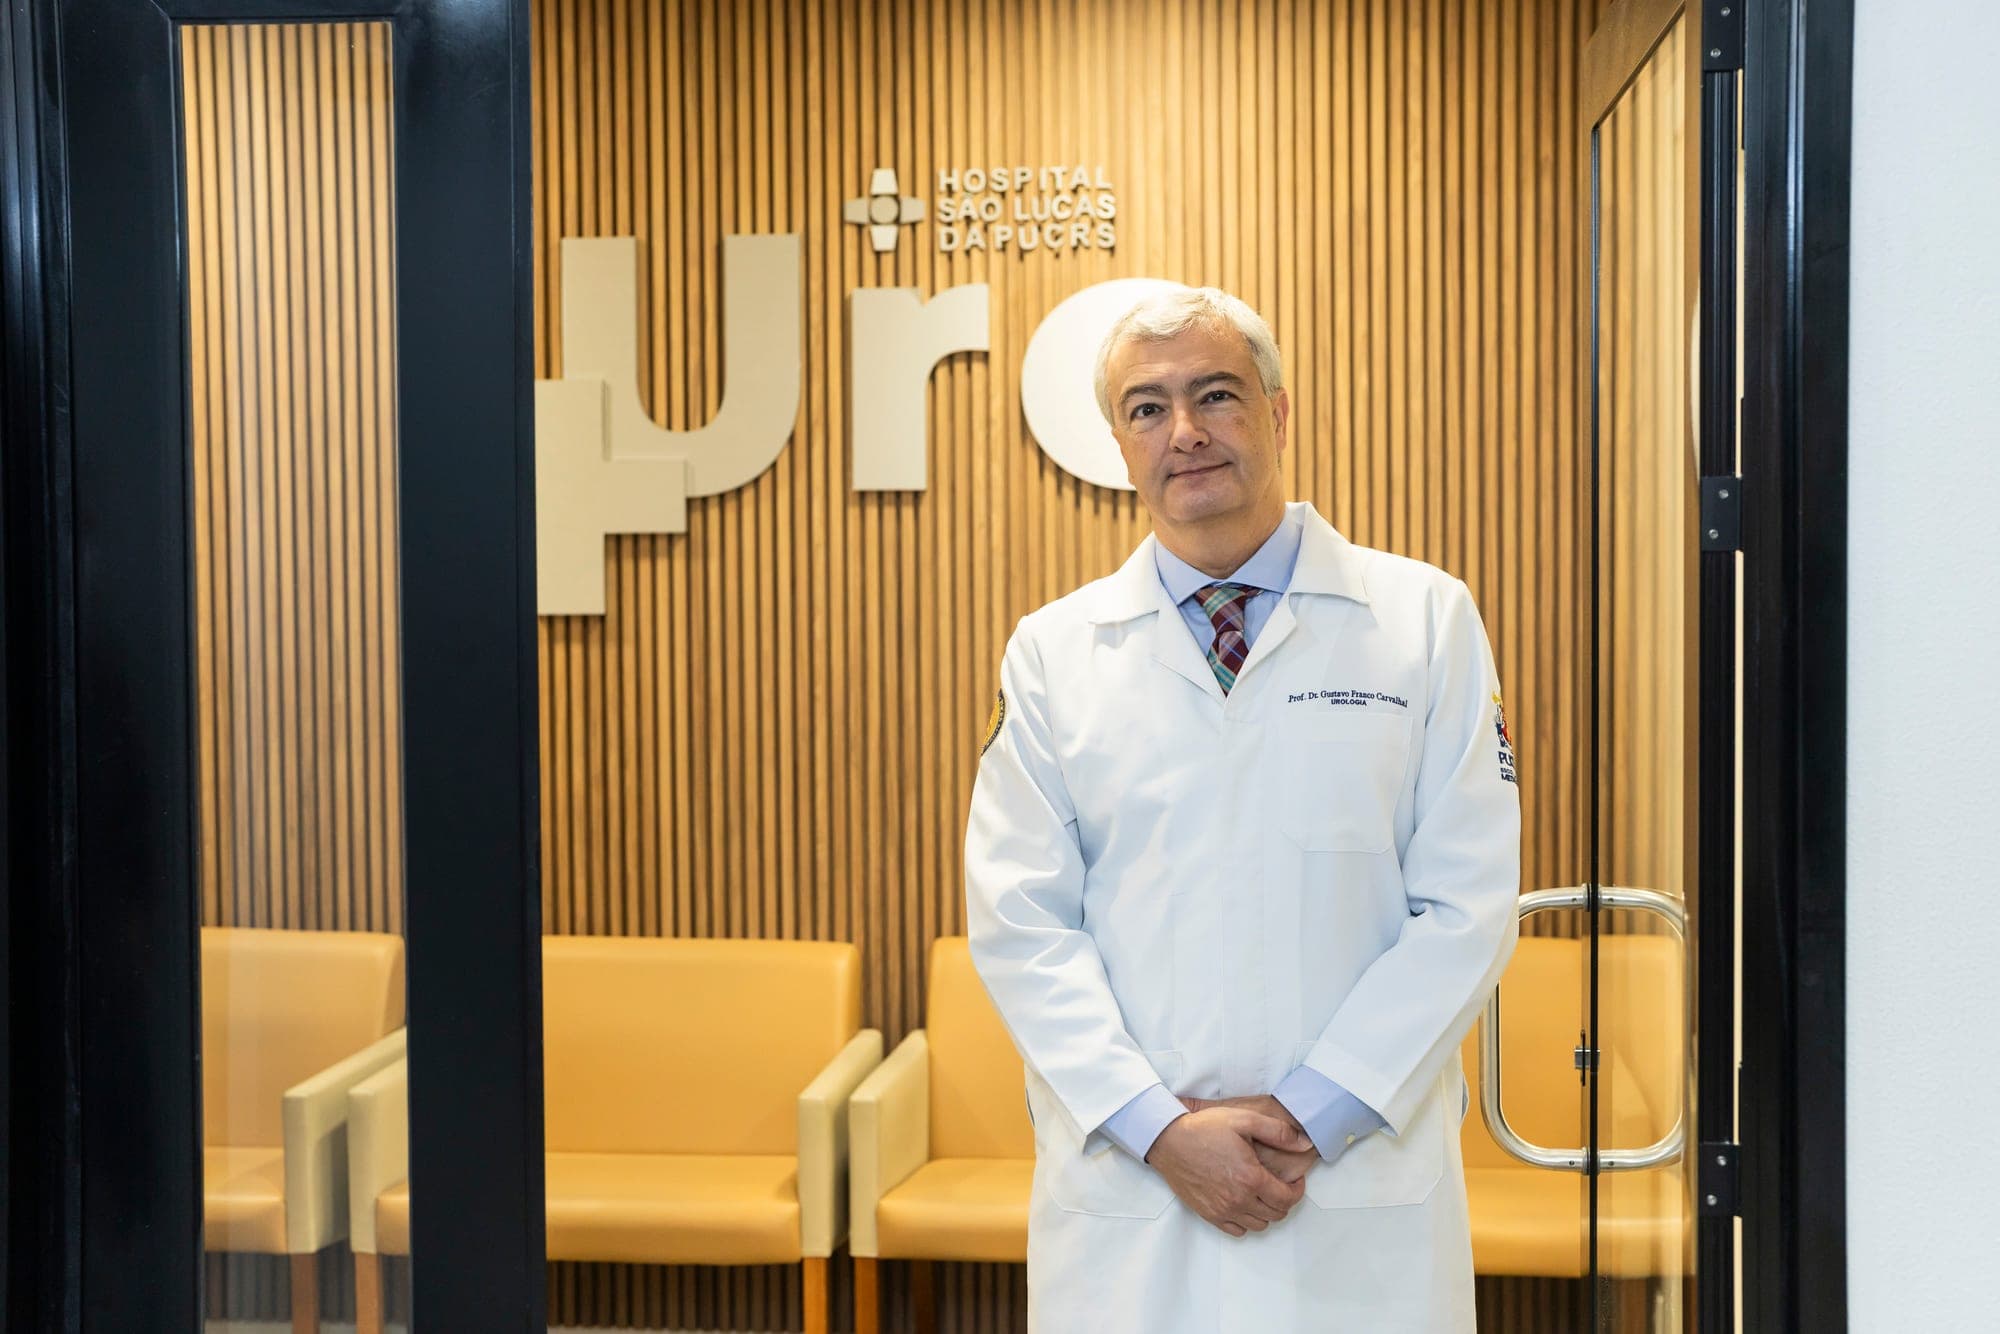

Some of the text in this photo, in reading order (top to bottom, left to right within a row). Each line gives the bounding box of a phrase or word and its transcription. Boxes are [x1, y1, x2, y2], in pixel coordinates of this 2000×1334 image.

[938, 165, 1113, 194] HOSPITAL
[1014, 194, 1116, 222] LUCAS
[1287, 693, 1306, 703] Prof.
[1320, 690, 1350, 699] Gustavo
[1351, 689, 1375, 699] Franco
[1376, 692, 1408, 708] Carvalhal
